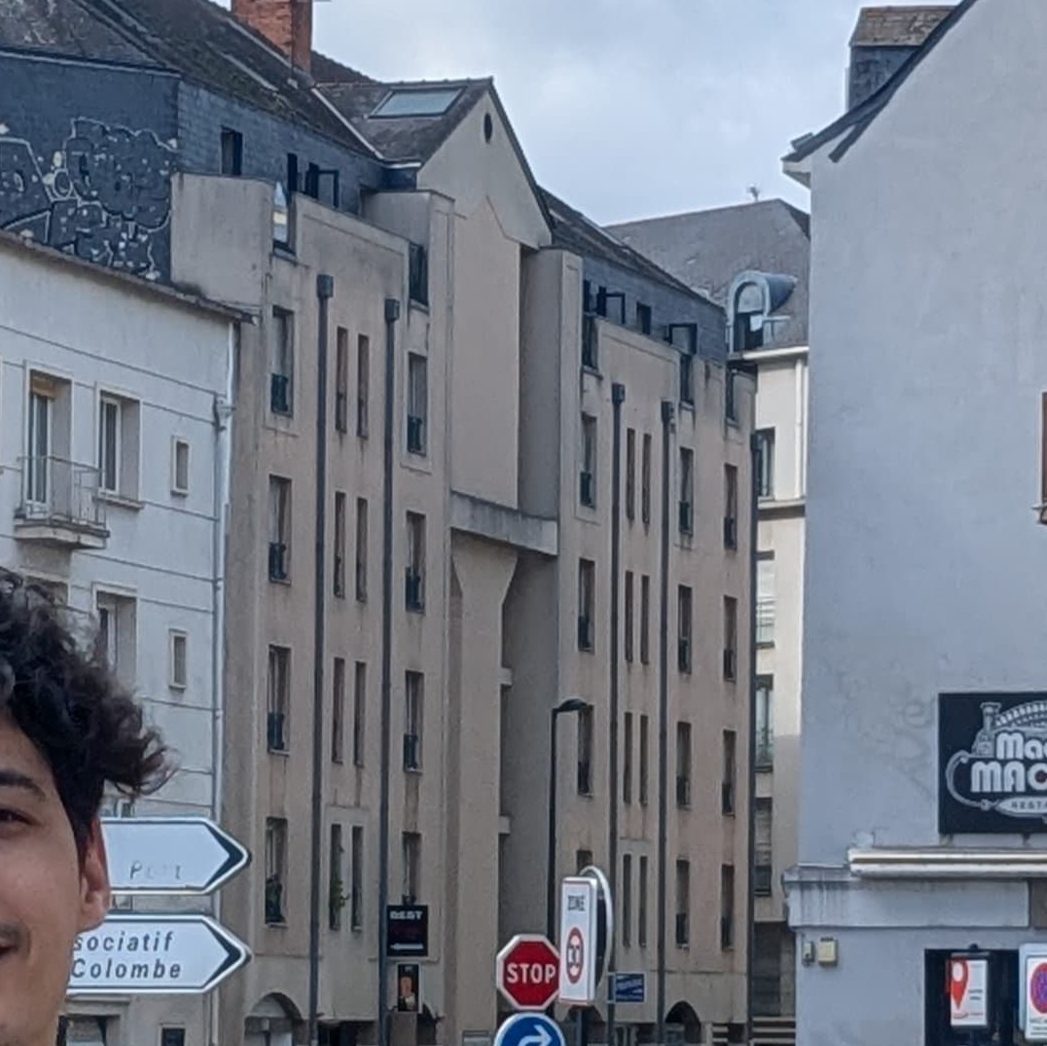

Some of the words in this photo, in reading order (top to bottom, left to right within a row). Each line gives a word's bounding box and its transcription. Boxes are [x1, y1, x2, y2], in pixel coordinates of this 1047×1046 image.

[996, 732, 1047, 760] Ma
[1011, 801, 1047, 810] REST
[71, 958, 182, 979] Colombe
[507, 963, 557, 984] STOP
